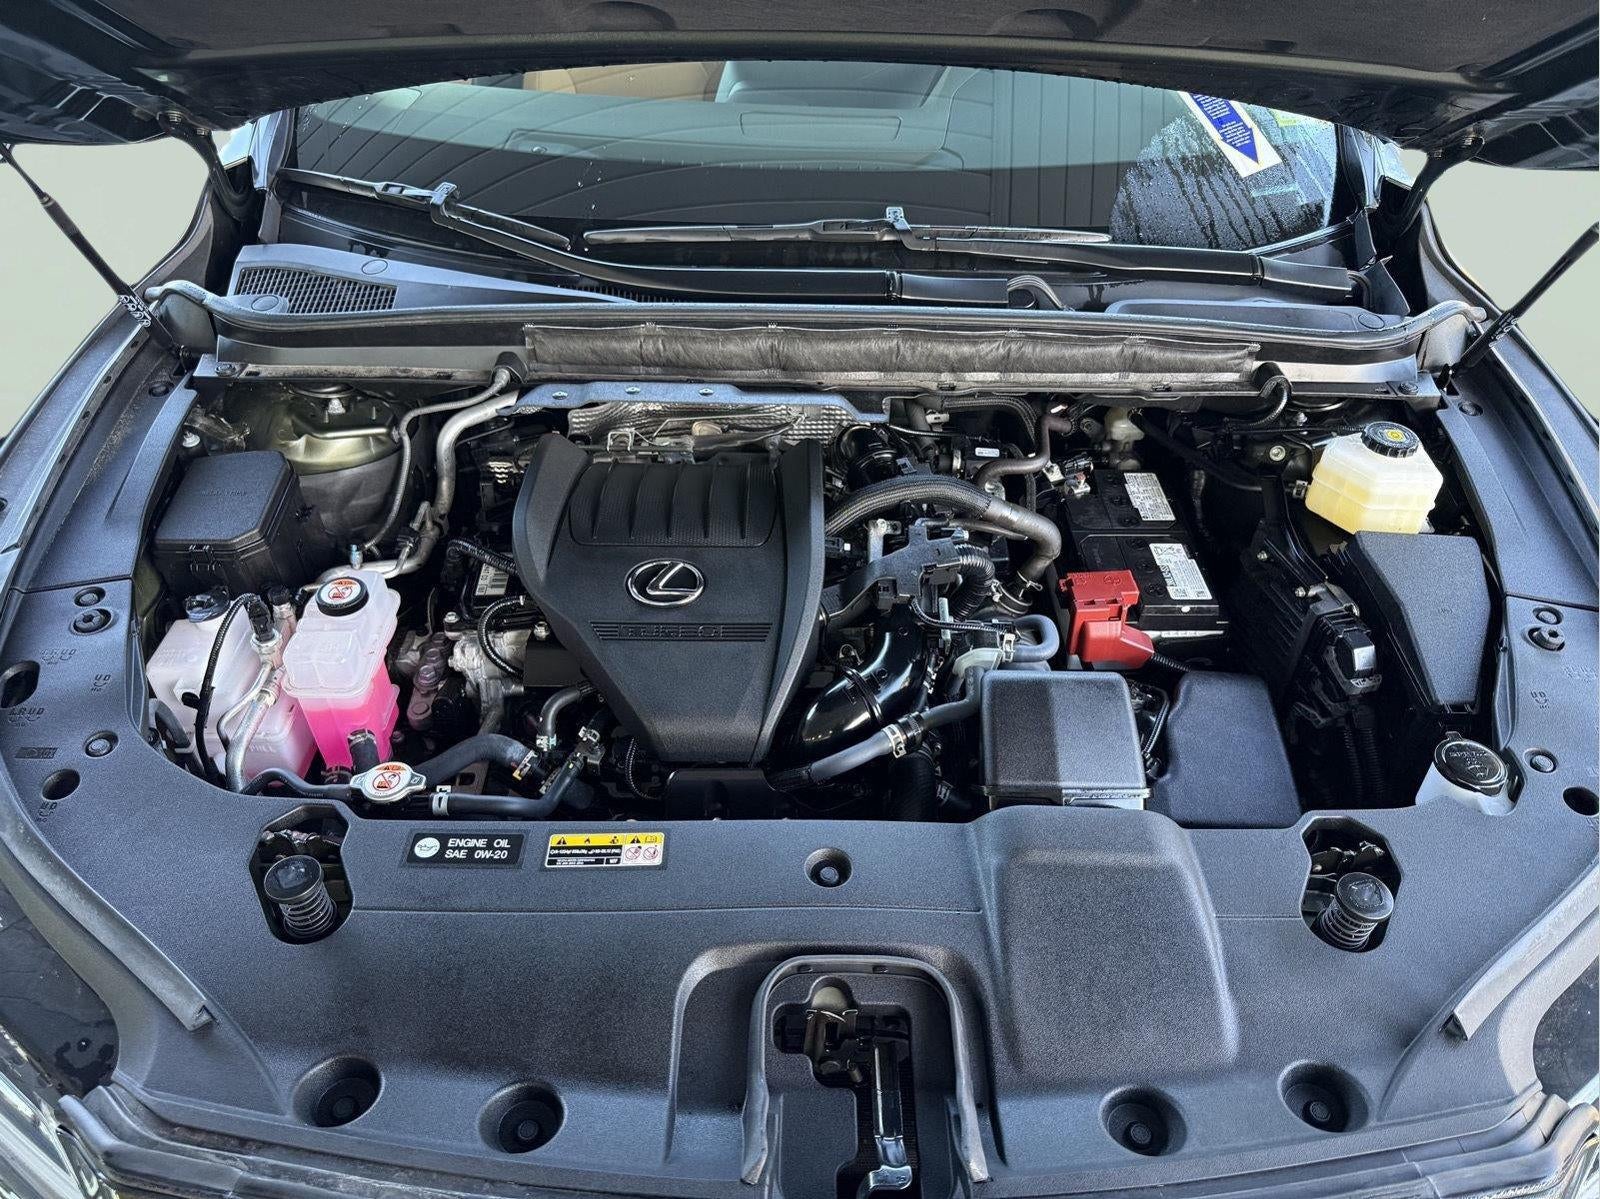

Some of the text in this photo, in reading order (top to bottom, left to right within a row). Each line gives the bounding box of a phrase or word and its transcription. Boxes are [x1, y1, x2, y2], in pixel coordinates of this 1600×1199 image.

[447, 838, 511, 848] ENGINE OIL
[444, 849, 508, 859] SAE 0W-20
